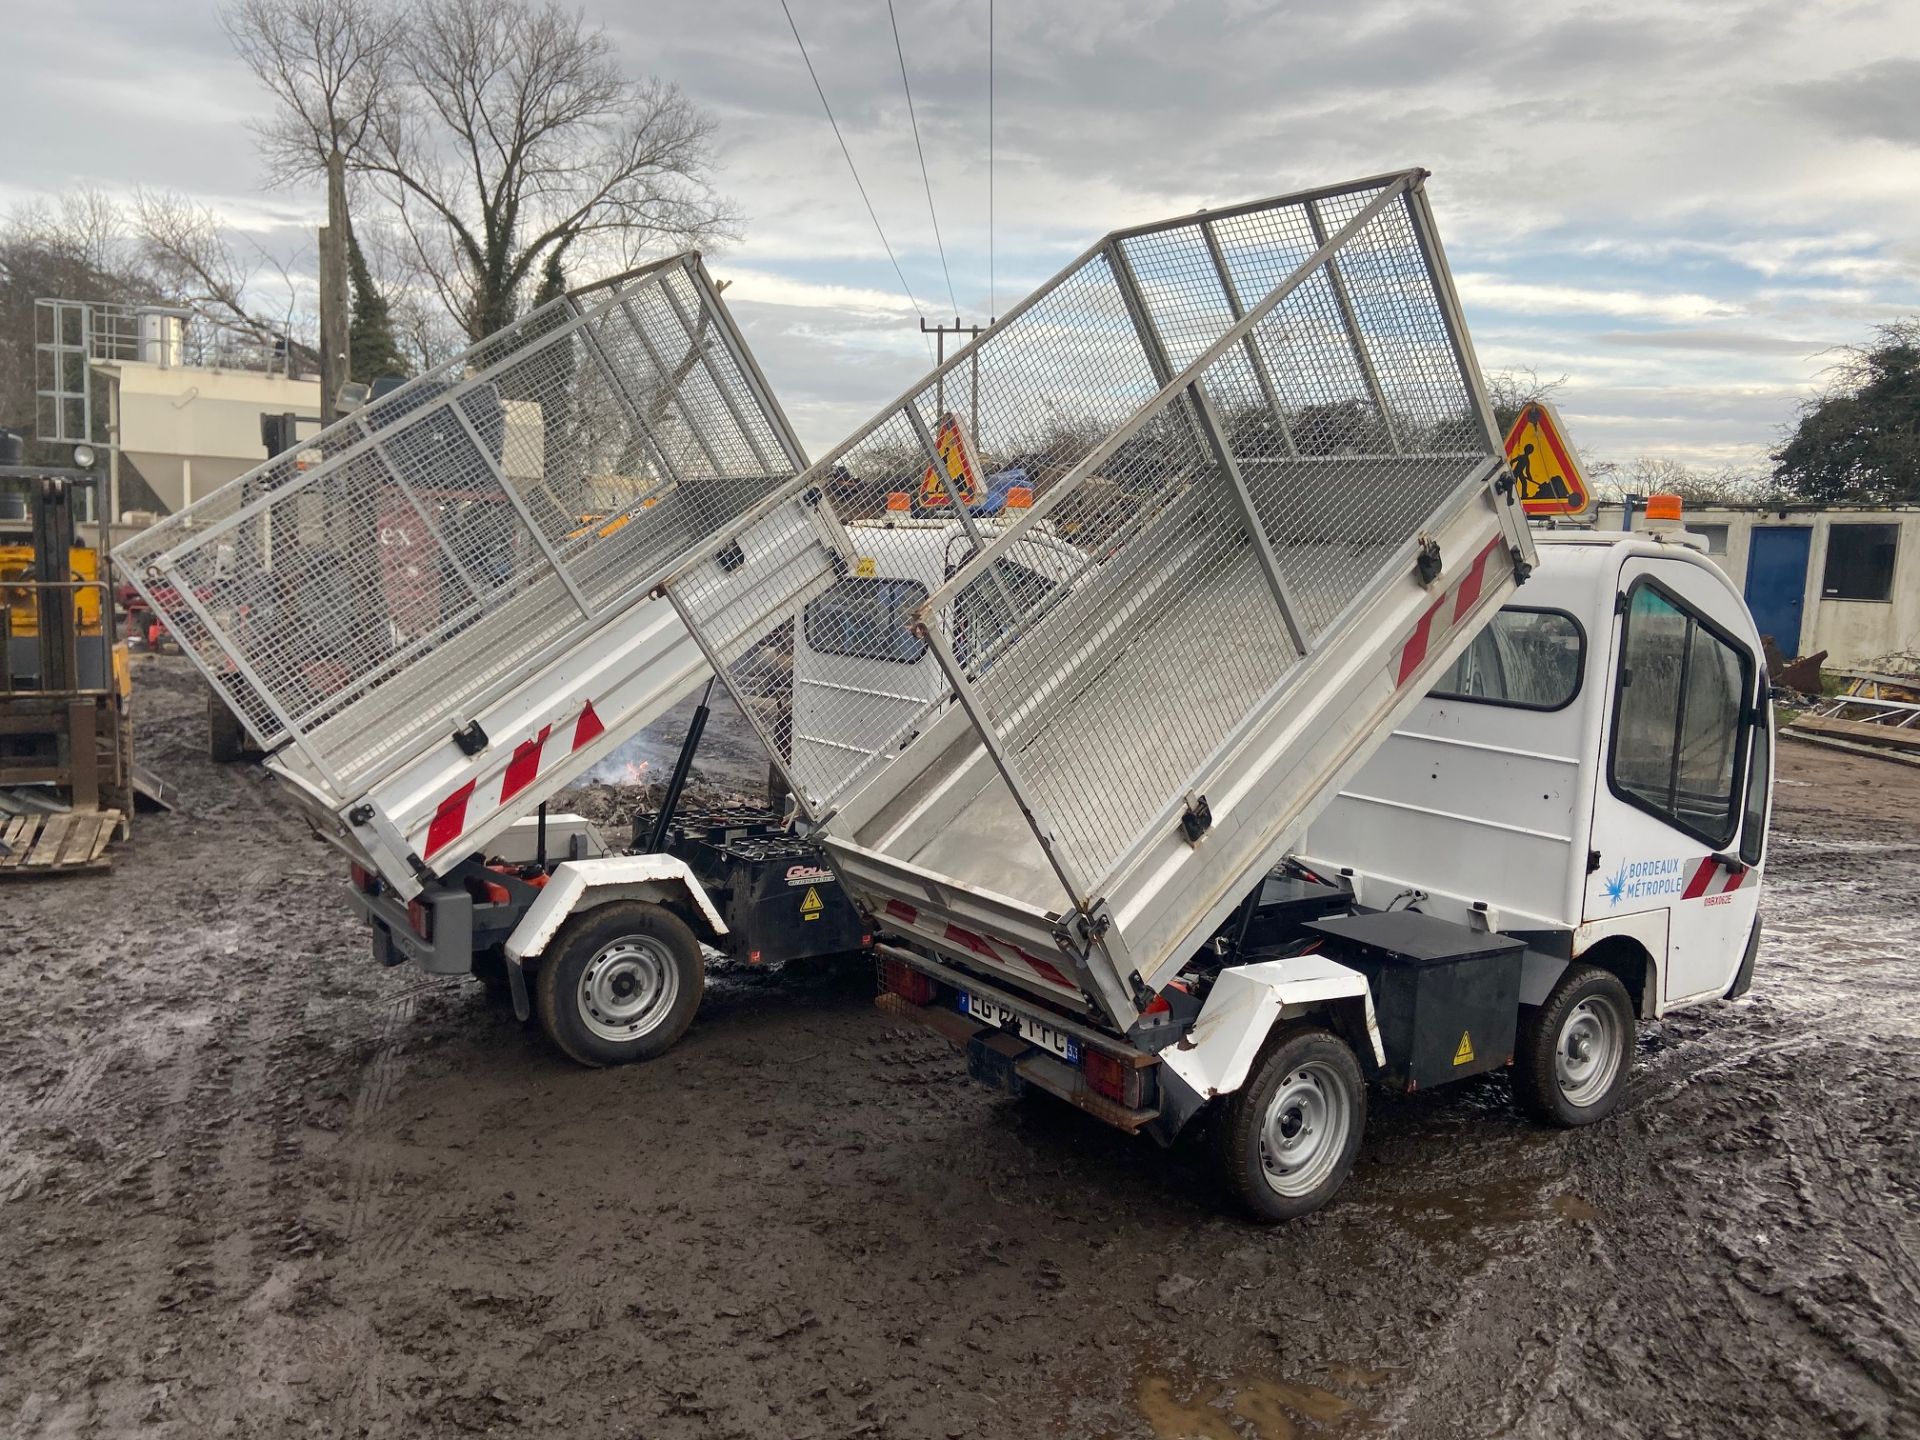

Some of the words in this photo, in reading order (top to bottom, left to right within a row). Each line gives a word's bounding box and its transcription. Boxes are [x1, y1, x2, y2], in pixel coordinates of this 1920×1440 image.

[1628, 858, 1680, 878] BORDEAUX
[1626, 877, 1683, 898] MÉTROPOLE
[1067, 1043, 1079, 1060] 33
